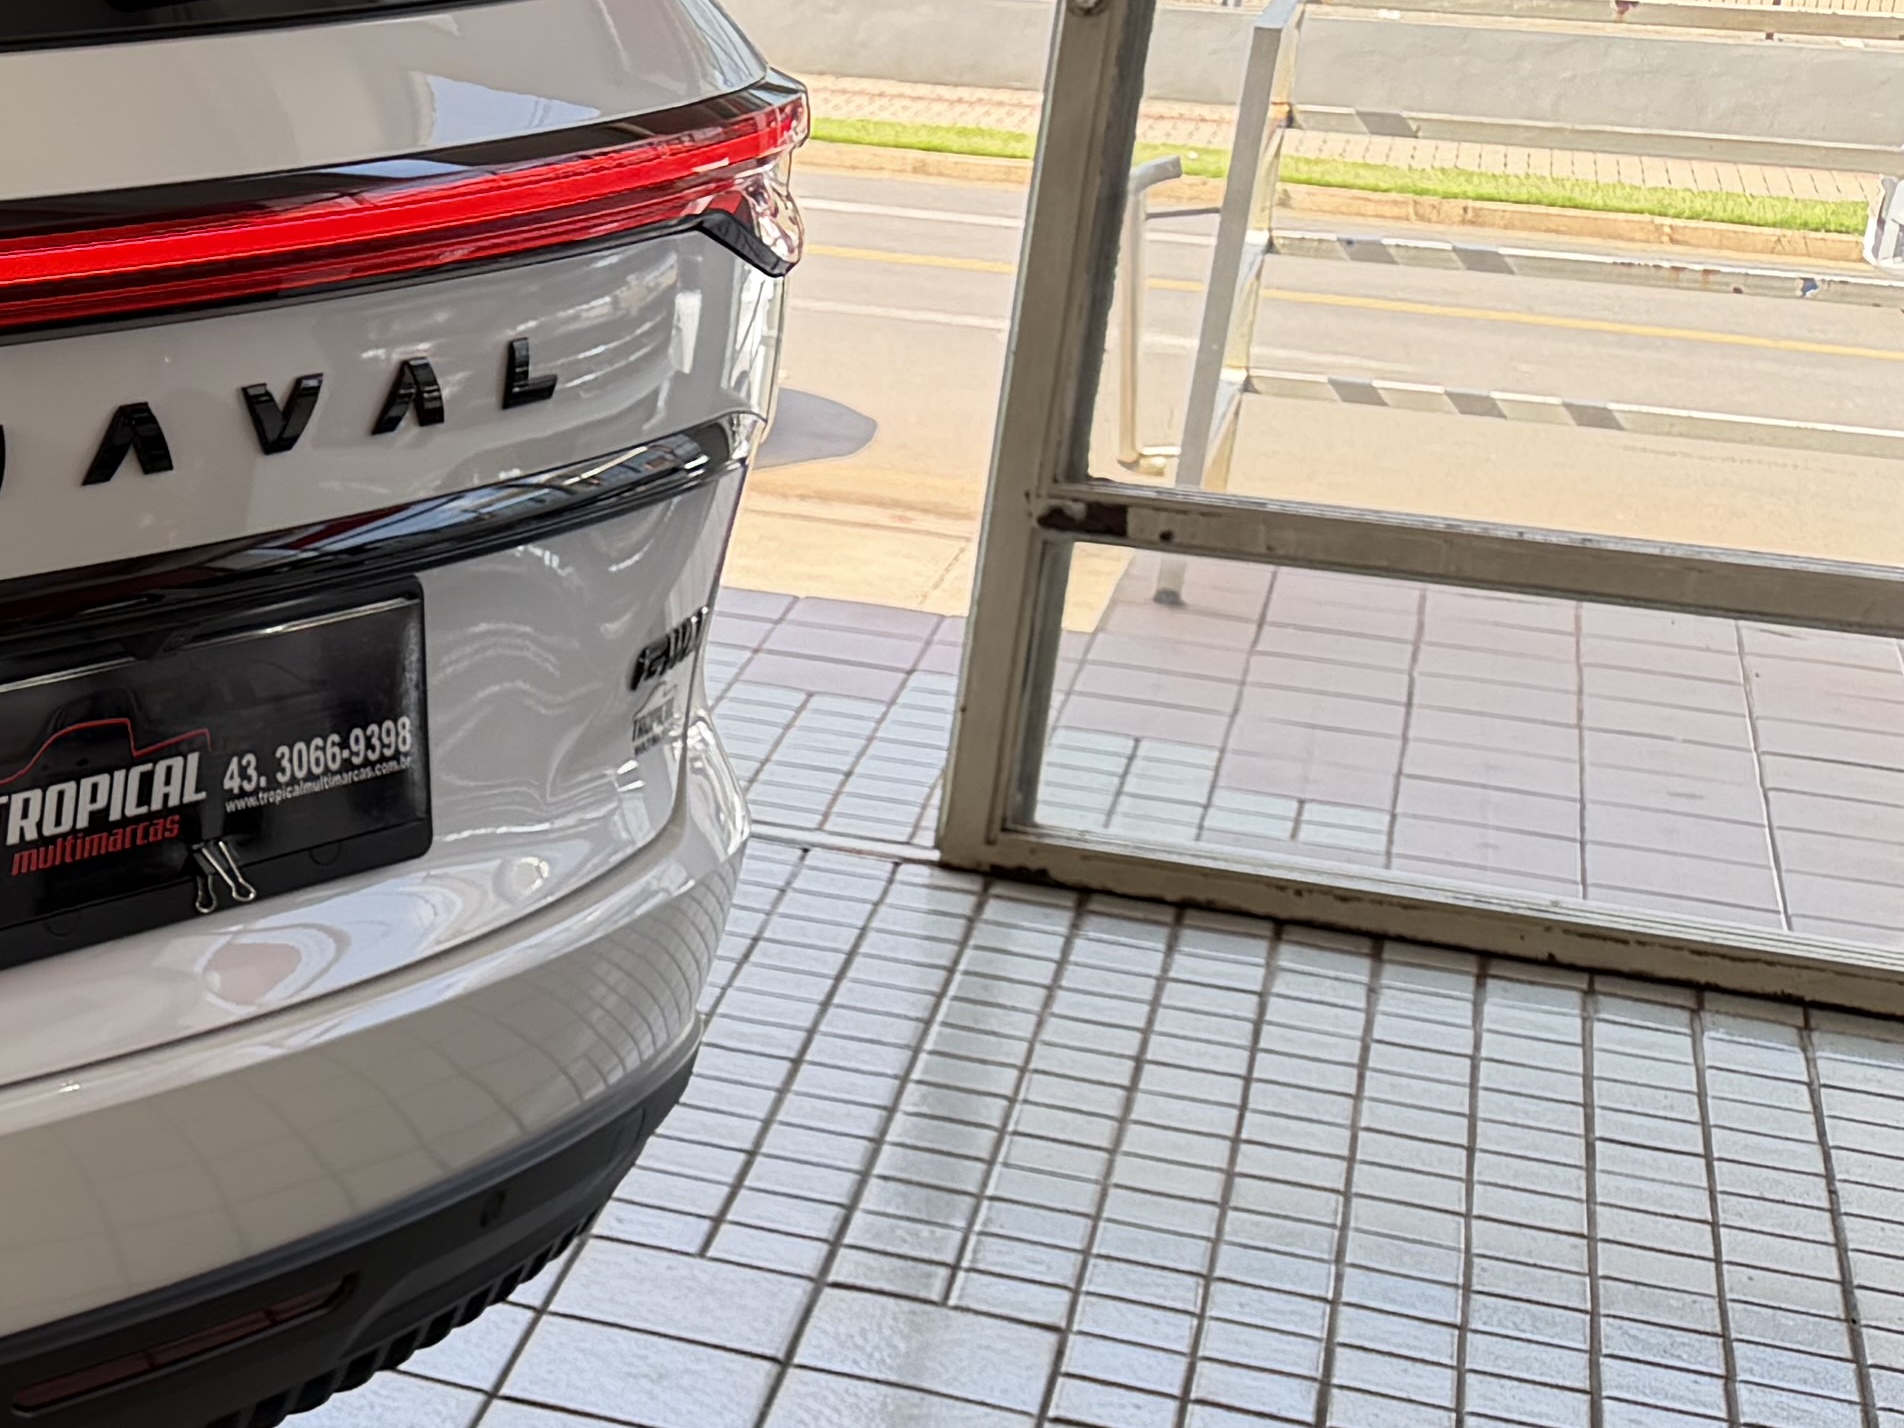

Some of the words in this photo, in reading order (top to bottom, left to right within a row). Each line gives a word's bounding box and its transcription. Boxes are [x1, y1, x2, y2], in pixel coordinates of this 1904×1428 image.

[223, 753, 268, 795] 43.
[274, 715, 412, 784] 3066-9398
[225, 755, 412, 813] www.tropicalmultimarcas.com.br
[11, 814, 181, 876] multimarcas
